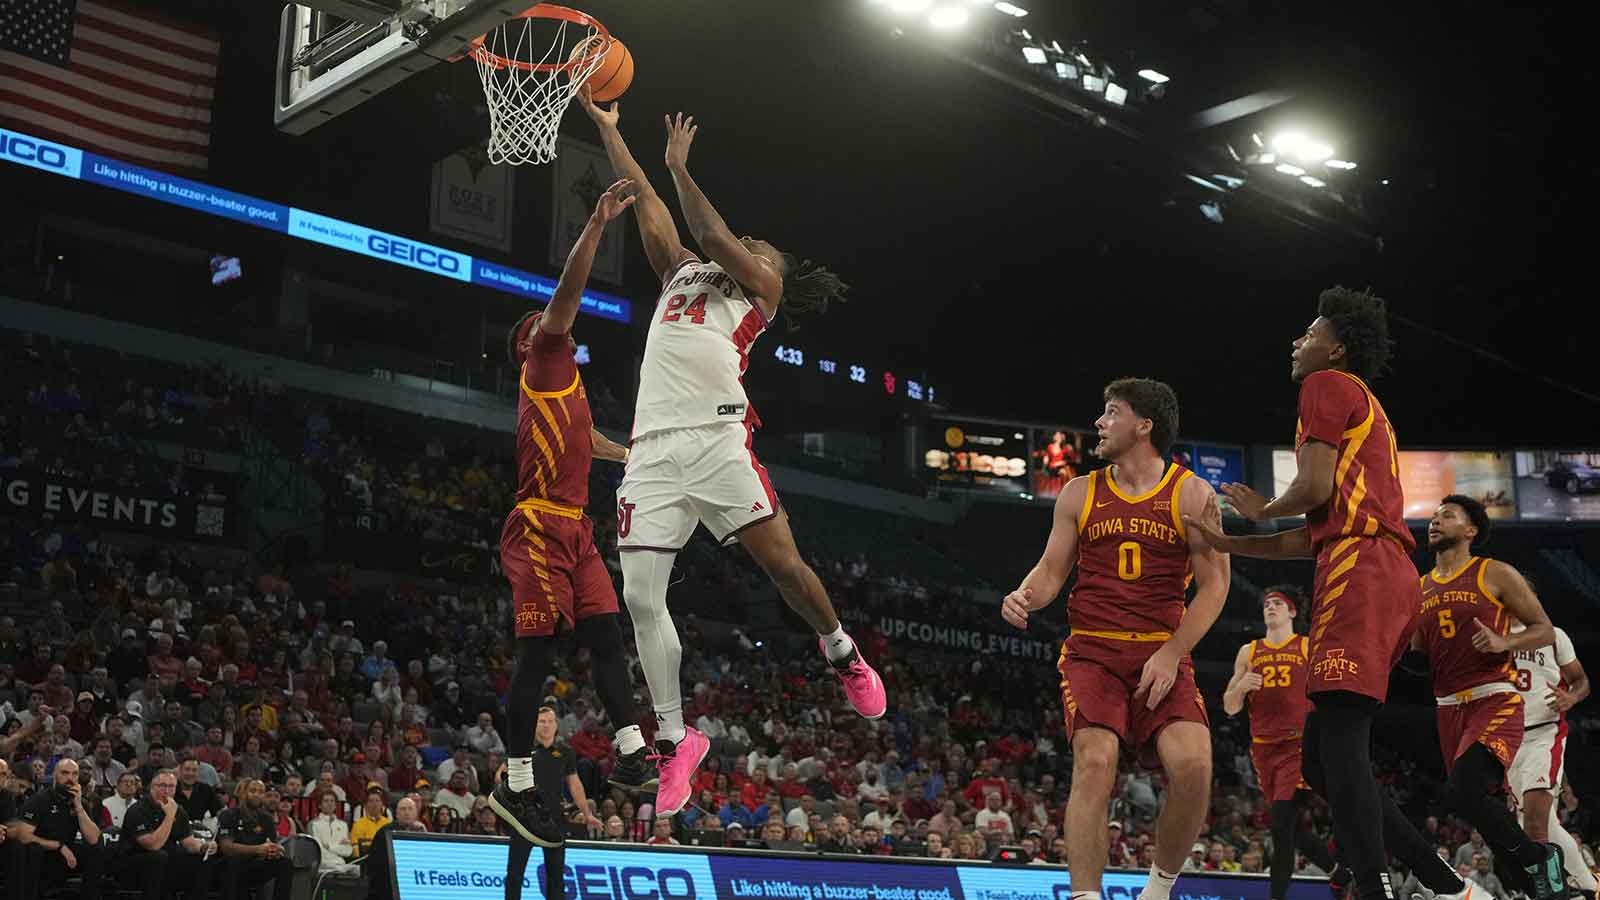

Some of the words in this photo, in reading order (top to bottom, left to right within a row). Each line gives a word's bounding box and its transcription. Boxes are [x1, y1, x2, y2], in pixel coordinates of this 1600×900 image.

[94, 162, 118, 178] Like
[120, 170, 157, 190] hitting
[169, 183, 246, 213] buzzer-beater
[248, 206, 279, 222] good.
[367, 233, 459, 274] GEICO
[480, 267, 499, 280] Like
[500, 270, 529, 290] hitting
[598, 299, 621, 315] good.
[684, 271, 737, 297] JOHN'S
[661, 292, 708, 325] 24
[775, 345, 803, 366] 4:33
[819, 359, 836, 373] 1ST
[850, 365, 866, 383] 32
[44, 484, 177, 528] EVENTS
[1088, 518, 1123, 542] IOWA
[1129, 518, 1177, 545] STATE
[1118, 541, 1141, 580] 0
[1443, 591, 1478, 604] STATE
[515, 610, 547, 624] STATE
[1438, 608, 1456, 638] 5
[880, 616, 983, 650] UPCOMING
[988, 634, 1053, 661] EVENTS
[1253, 653, 1274, 666] IOWA
[1276, 652, 1303, 665] STATE
[1314, 657, 1360, 676] STATE
[1512, 649, 1545, 667] OHN'S
[1262, 665, 1292, 688] 23
[414, 869, 427, 885] It
[429, 870, 468, 887] Feels
[731, 880, 762, 897] Like
[764, 880, 811, 900] hitting
[813, 886, 822, 898] a
[824, 881, 916, 900] buzzer-beater
